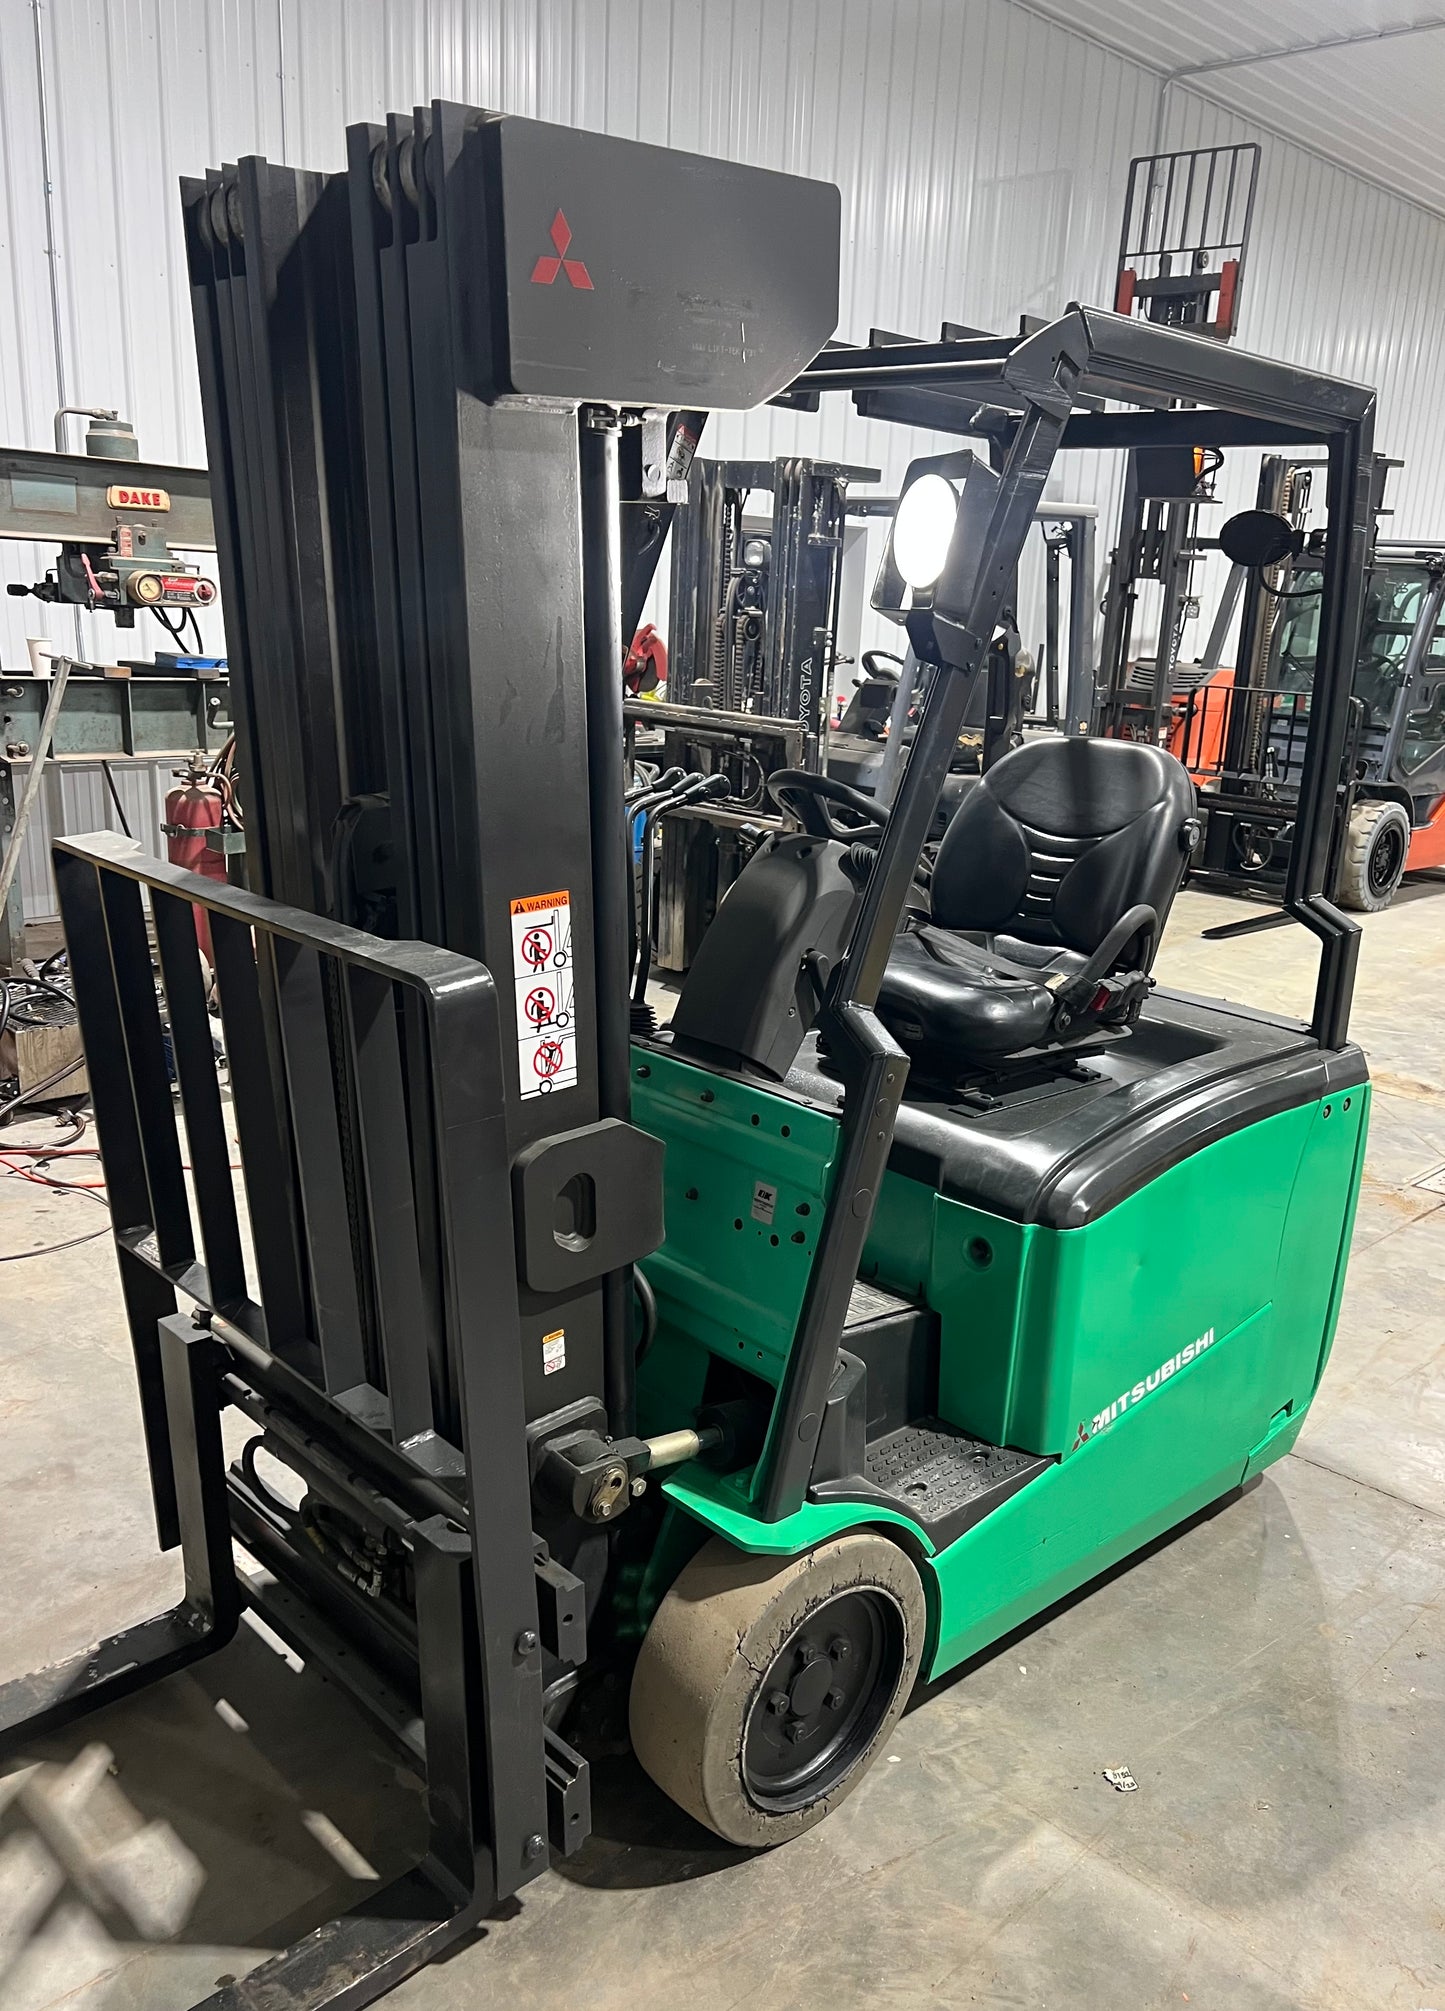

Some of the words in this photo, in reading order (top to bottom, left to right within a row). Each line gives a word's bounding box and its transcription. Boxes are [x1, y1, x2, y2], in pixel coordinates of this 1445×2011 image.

[118, 490, 161, 507] DAKE
[1168, 623, 1180, 672] TOYOTA
[799, 657, 813, 732] YOTA
[526, 895, 568, 911] WARNING
[1092, 1326, 1215, 1435] MITSUBISHI
